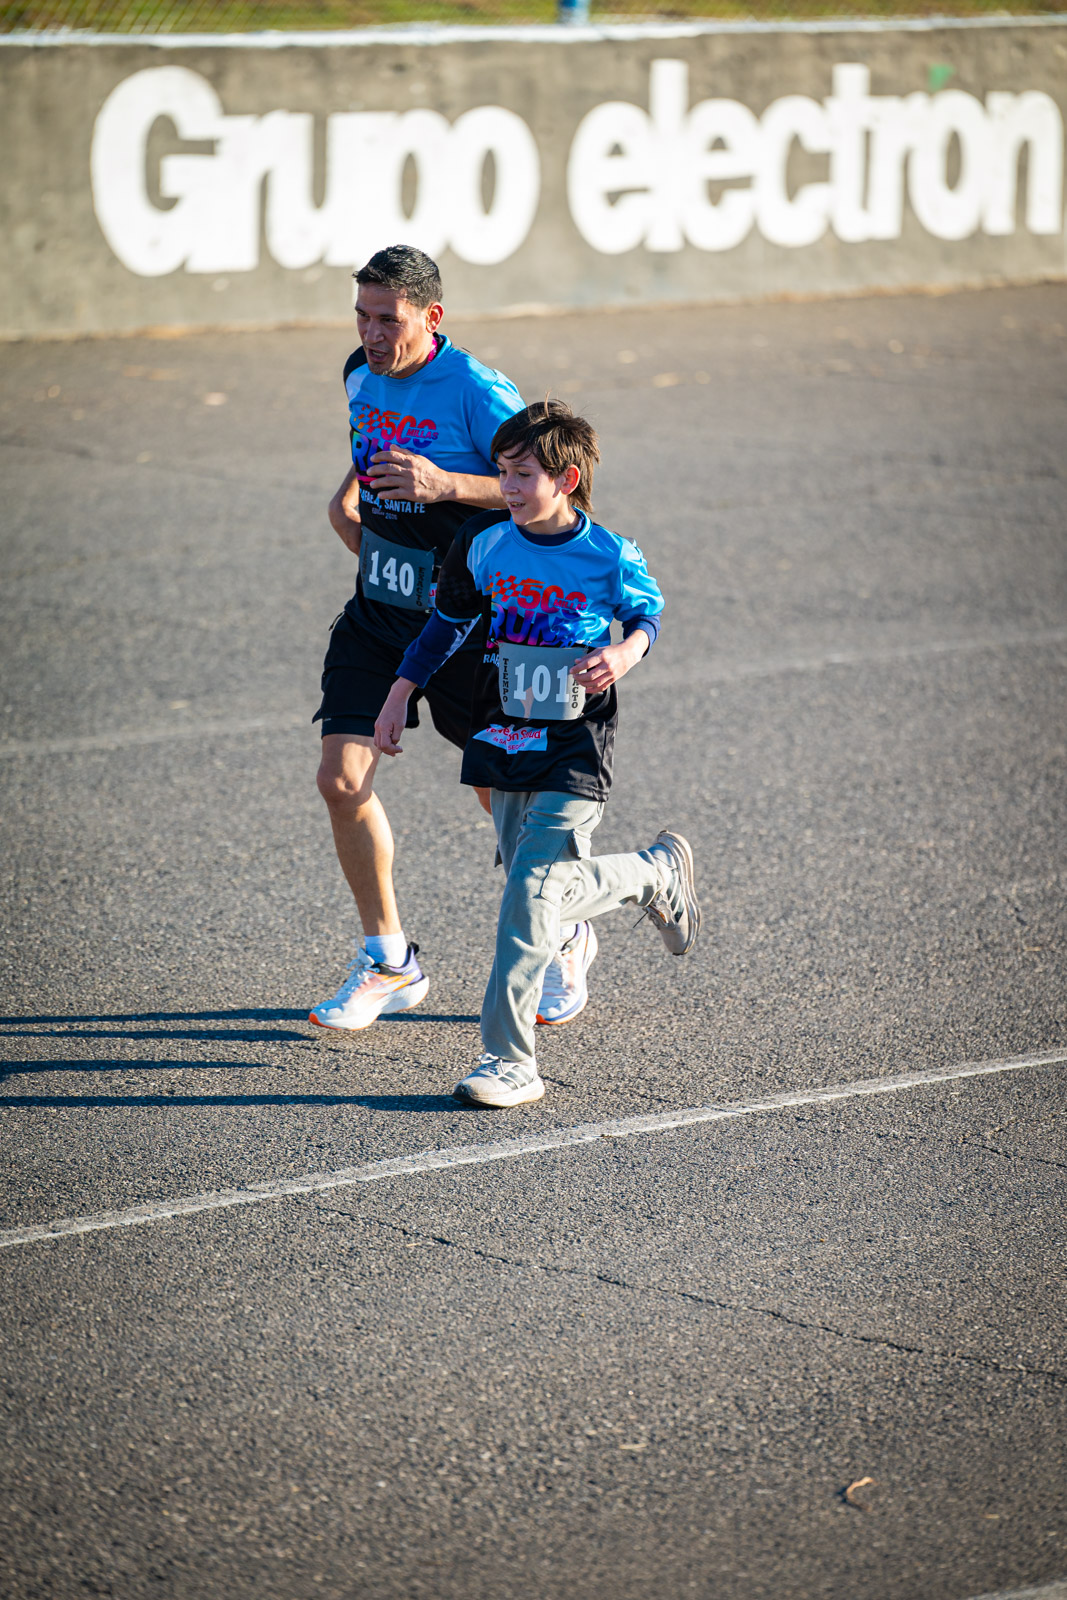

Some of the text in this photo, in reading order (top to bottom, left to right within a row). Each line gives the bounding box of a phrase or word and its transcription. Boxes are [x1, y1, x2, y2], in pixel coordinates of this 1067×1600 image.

[90, 66, 540, 305] Grupo
[407, 428, 439, 441] MILLAS
[384, 499, 412, 514] SANTA
[413, 502, 426, 514] FE
[368, 550, 415, 597] 140
[517, 578, 587, 619] 500
[502, 657, 510, 703] TIEMPO
[513, 662, 570, 703] 101
[571, 679, 580, 709] ACTO
